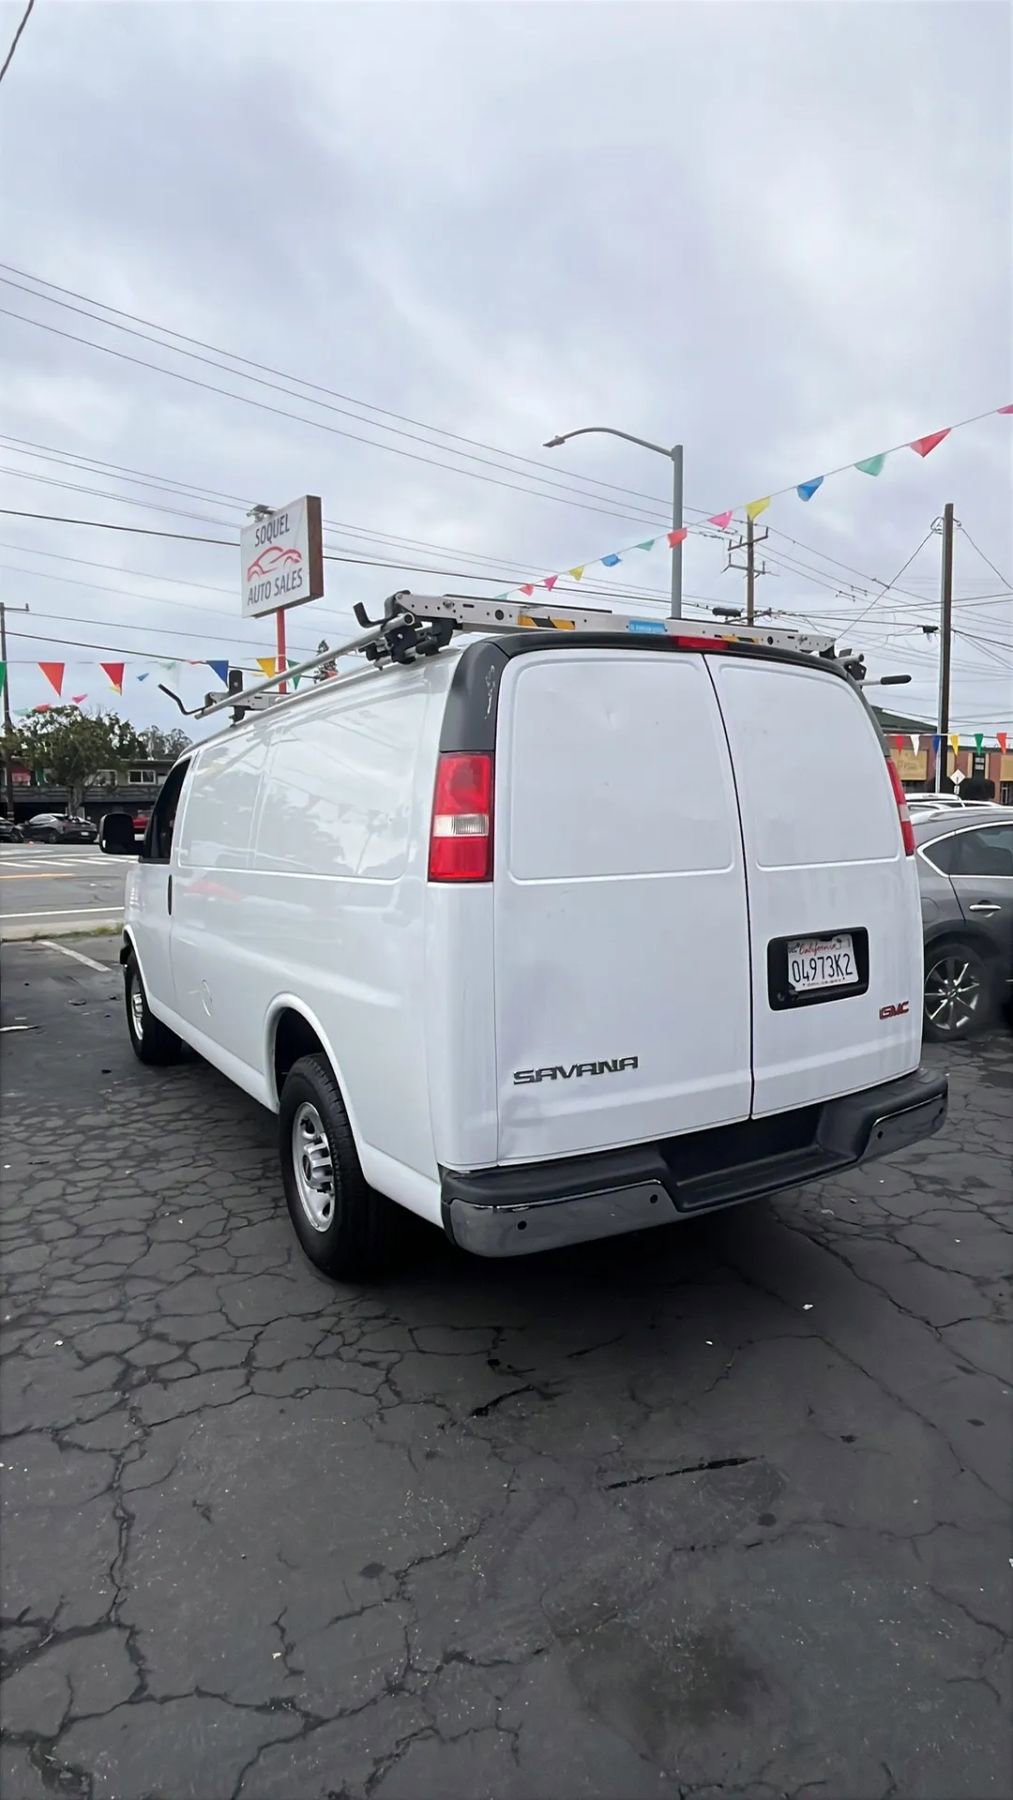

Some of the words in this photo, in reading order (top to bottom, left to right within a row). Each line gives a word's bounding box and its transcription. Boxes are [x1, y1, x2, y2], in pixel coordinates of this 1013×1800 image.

[255, 513, 290, 547] SOQUEL
[247, 580, 272, 605] AUTO
[274, 567, 303, 596] SALES
[799, 942, 836, 956] California
[792, 953, 853, 983] 04973K2
[879, 1001, 909, 1020] GMC
[513, 1056, 639, 1085] SAVANA
